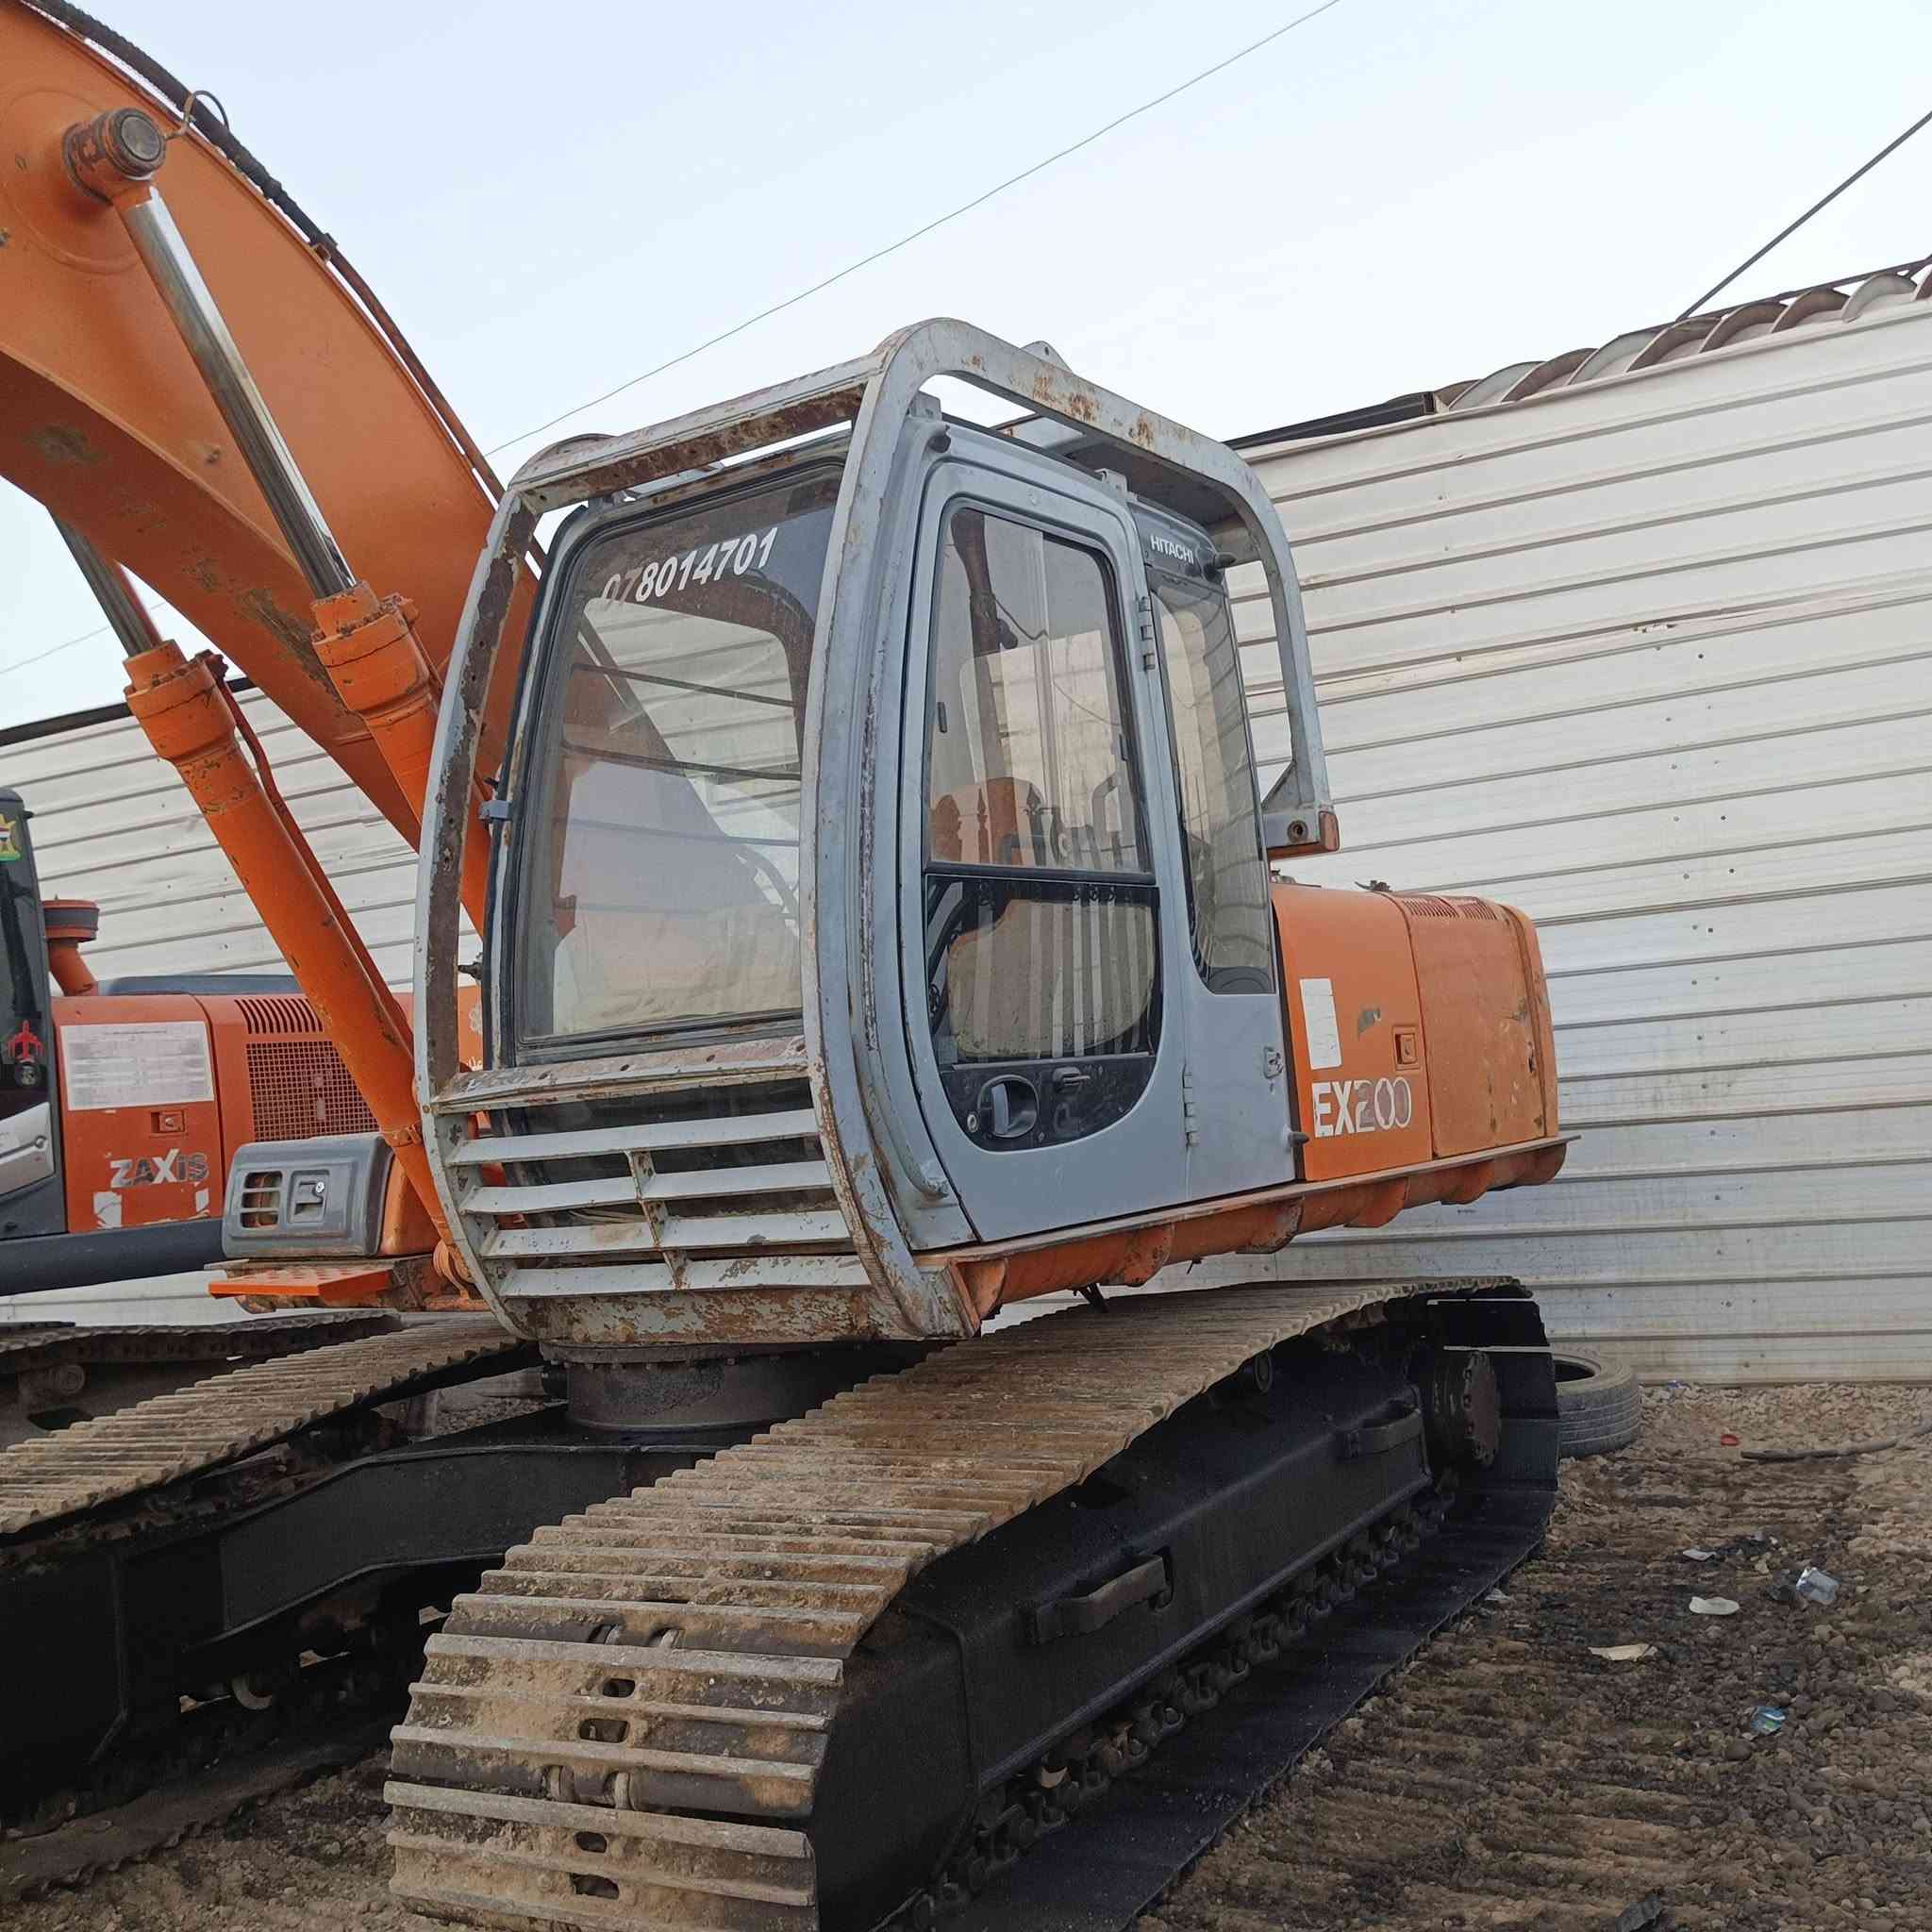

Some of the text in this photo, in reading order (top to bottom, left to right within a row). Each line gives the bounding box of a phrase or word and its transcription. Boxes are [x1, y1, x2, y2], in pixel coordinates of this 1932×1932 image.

[1150, 535, 1194, 564] HITACHI
[1312, 1076, 1412, 1138] EX200
[109, 1148, 209, 1189] ZAXIS
